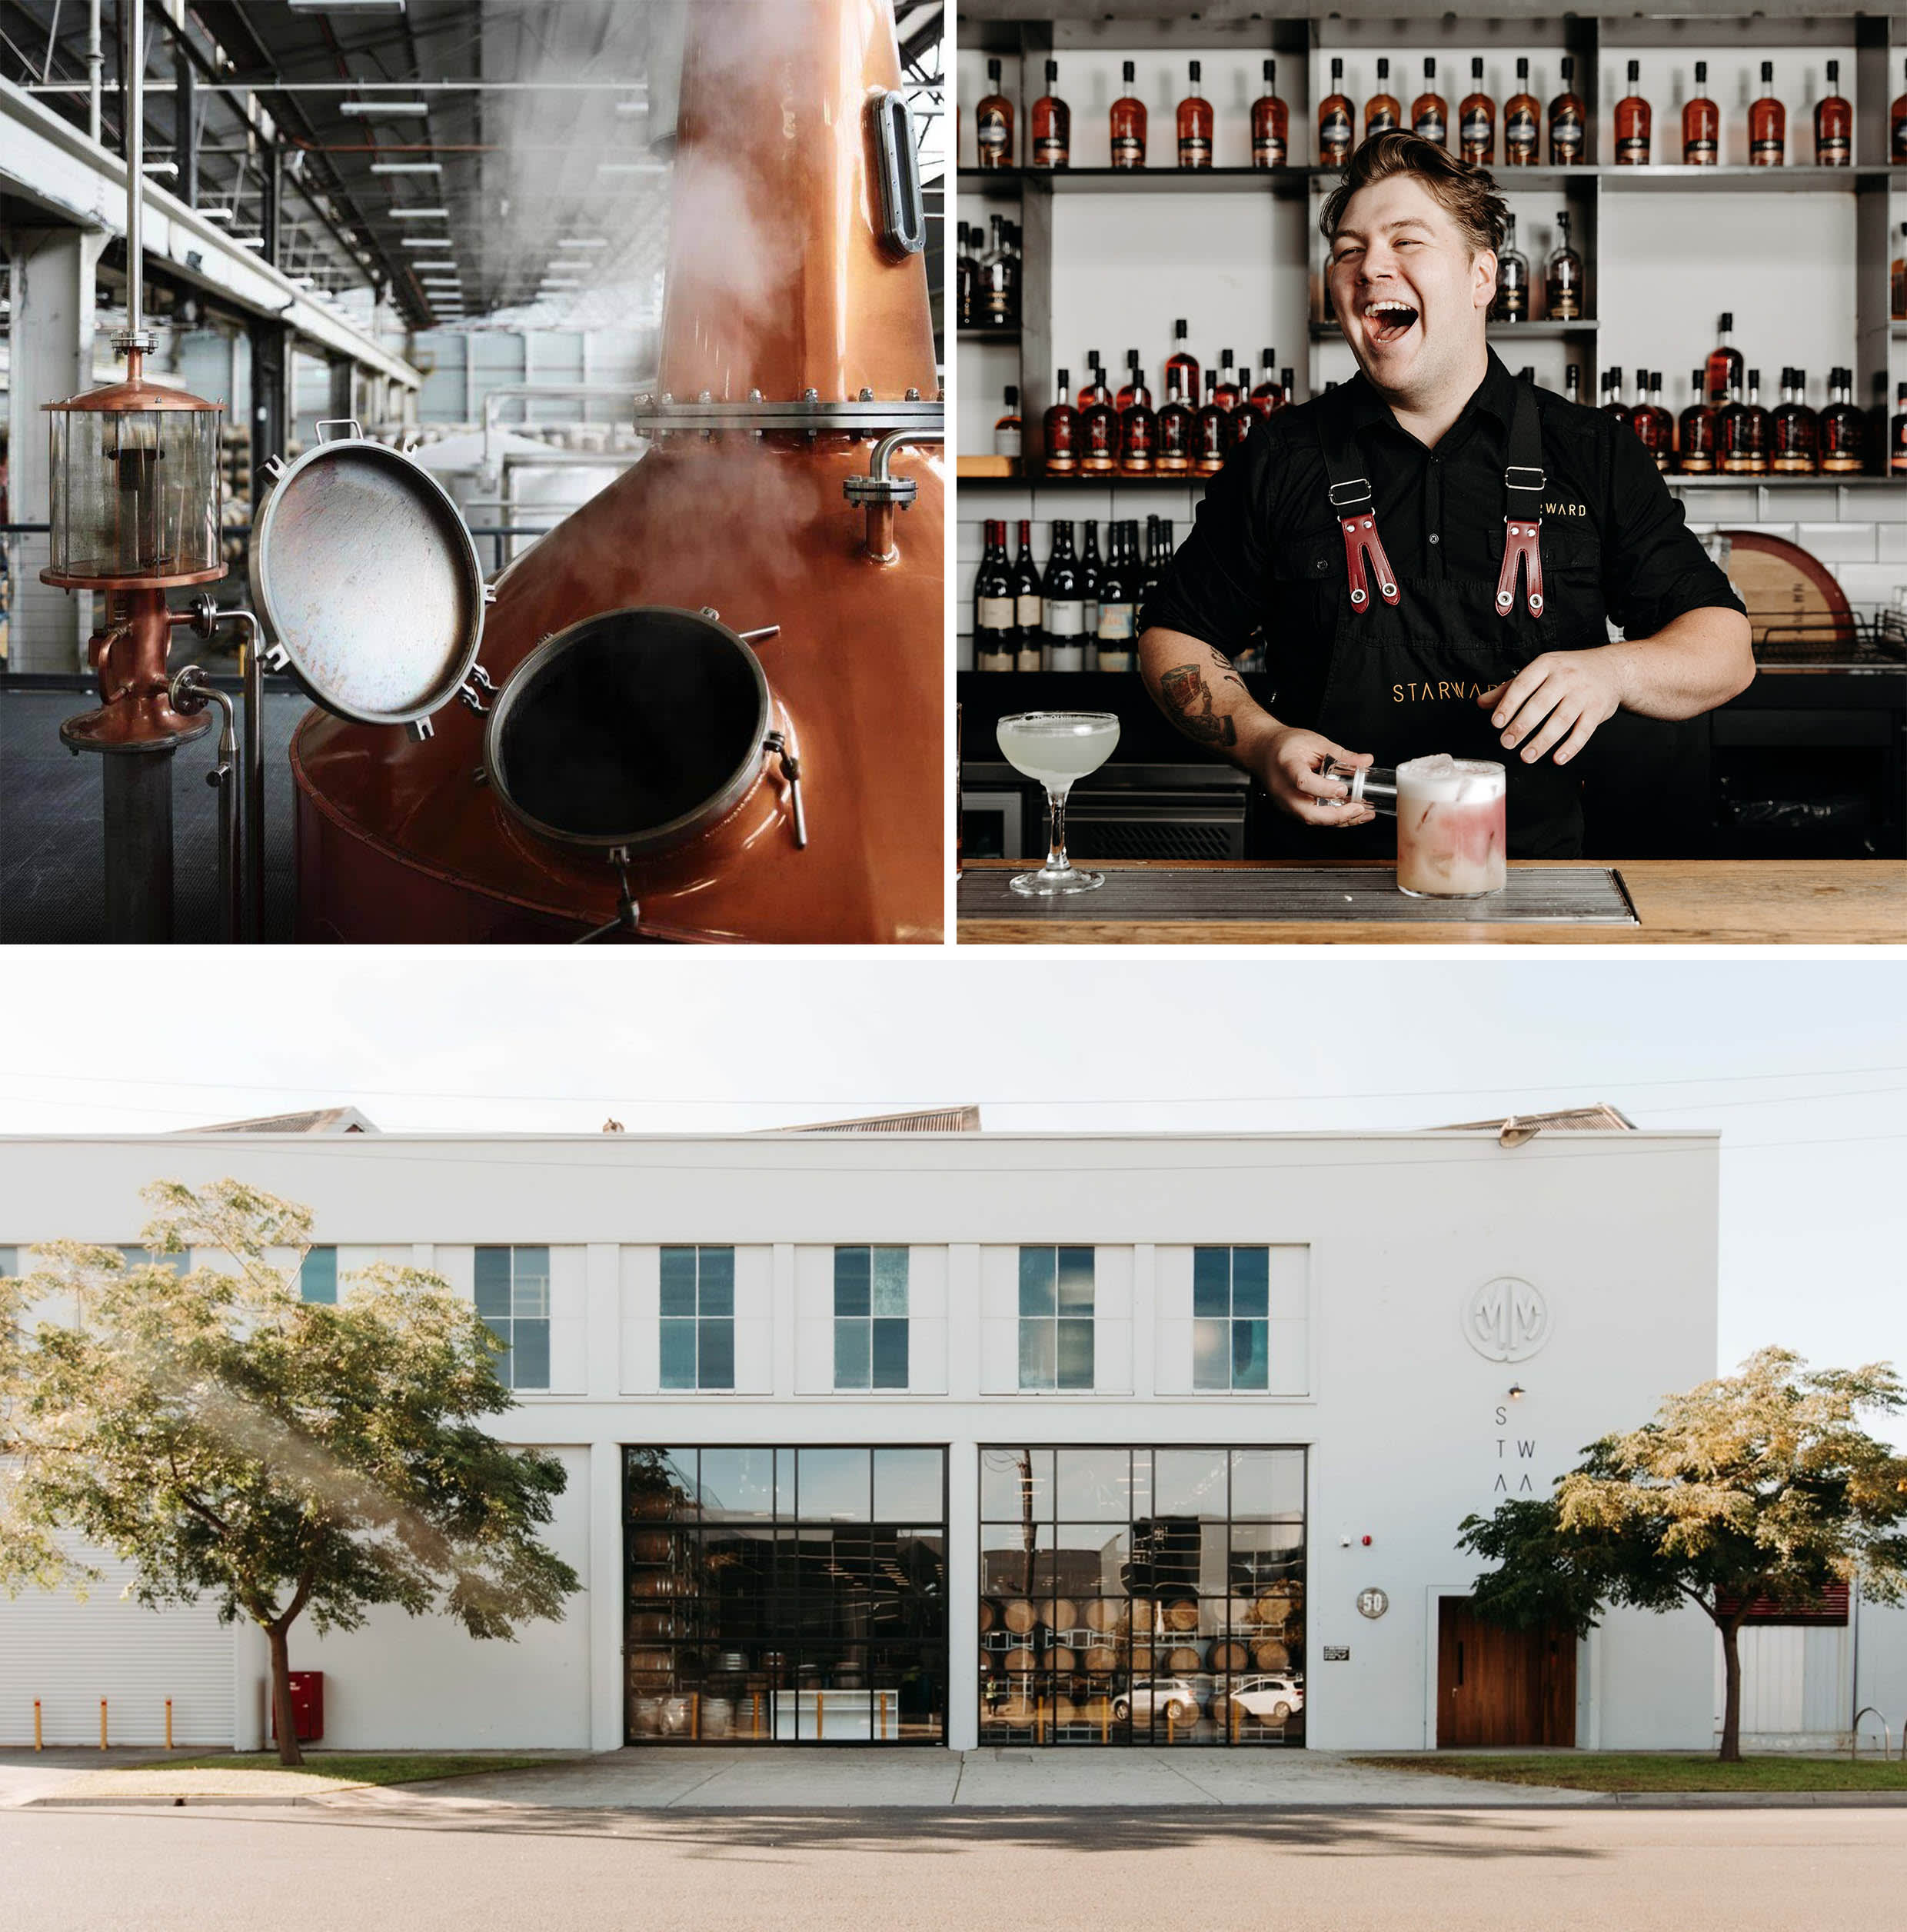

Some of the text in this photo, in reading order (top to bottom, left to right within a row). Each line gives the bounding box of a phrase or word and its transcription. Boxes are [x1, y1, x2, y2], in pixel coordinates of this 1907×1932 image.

[1540, 503, 1586, 516] WARD
[1393, 681, 1498, 702] STARWA
[1363, 1594, 1383, 1612] 50
